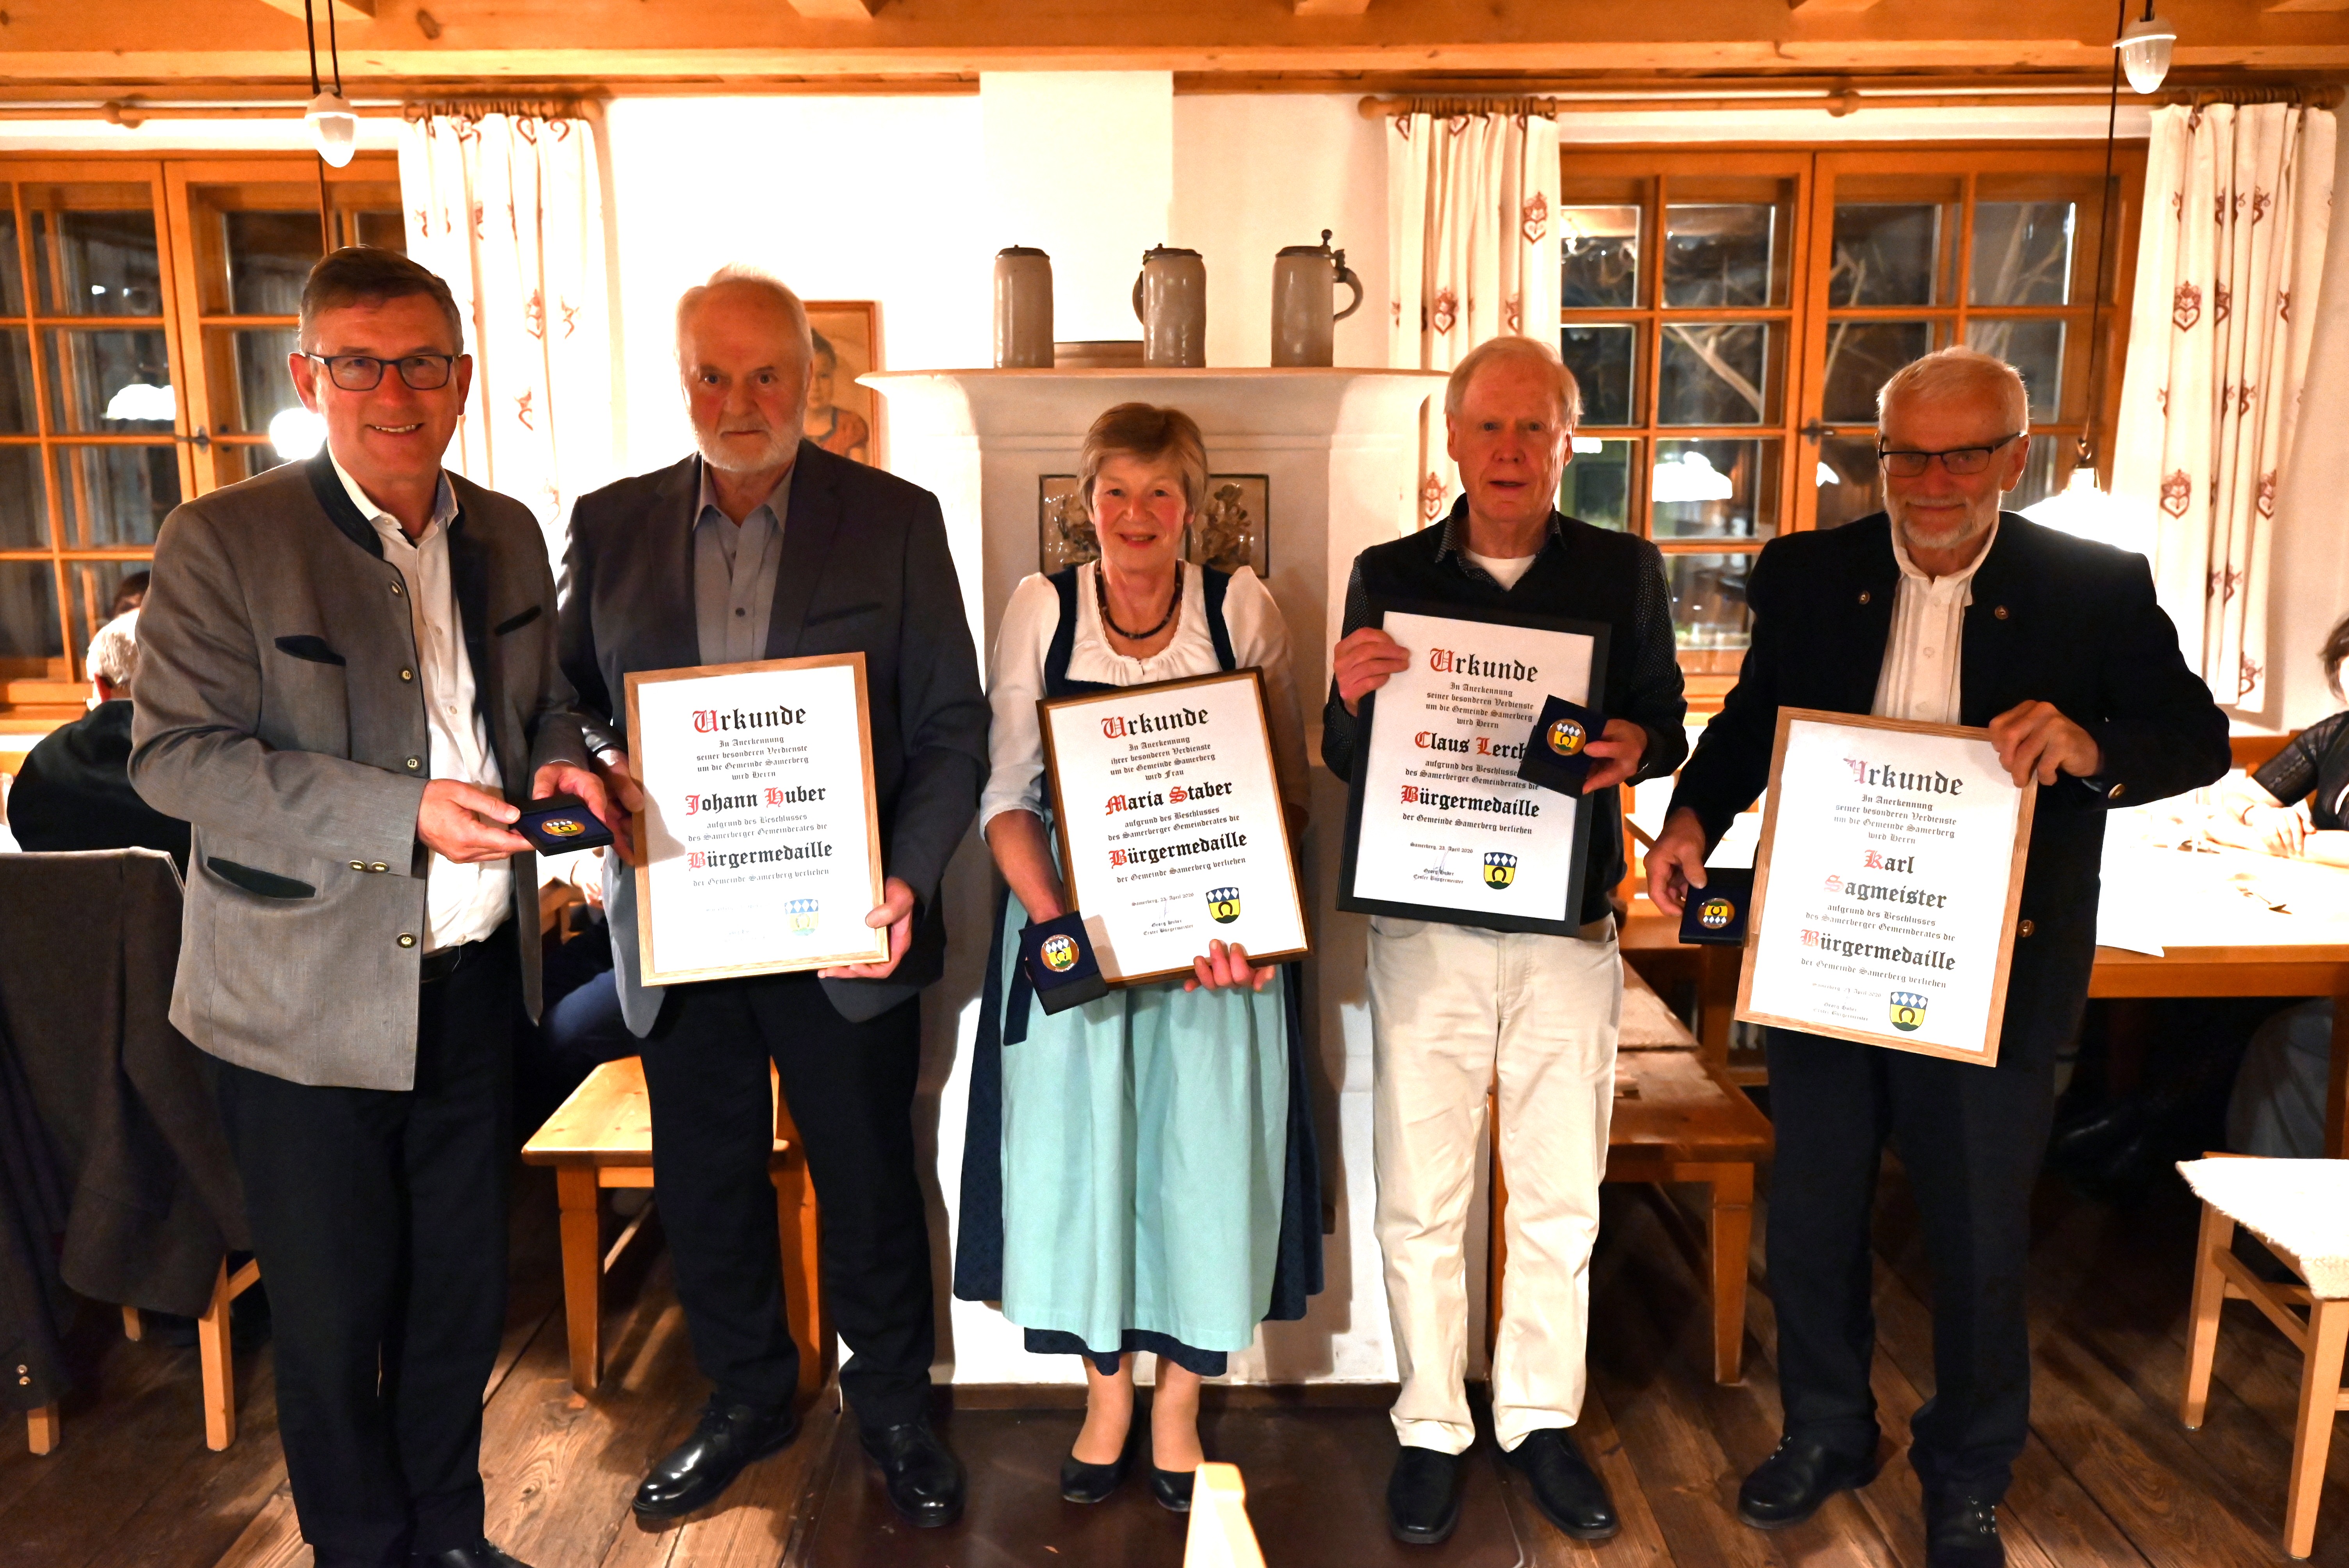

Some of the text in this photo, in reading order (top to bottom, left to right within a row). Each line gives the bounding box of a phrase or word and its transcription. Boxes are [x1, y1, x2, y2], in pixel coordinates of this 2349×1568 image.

[1430, 648, 1538, 682] Urkunde
[1449, 682, 1513, 697] In Anerkennung
[1451, 694, 1492, 705] besonderen
[1494, 698, 1534, 710] Verdienste
[692, 705, 806, 733] Urkunde
[1101, 707, 1209, 739] Urkunde
[1452, 705, 1488, 716] Gemeinde
[1490, 709, 1533, 722] Samerberg
[1476, 718, 1499, 729] Herrn
[722, 750, 764, 758] besonderen
[766, 746, 807, 754] Verdienste
[732, 737, 784, 746] Anerkennung
[1141, 737, 1191, 749] Anerkennung
[1415, 731, 1470, 753] Claus
[1130, 750, 1170, 761] besonderen
[1172, 744, 1211, 755] Verdienste
[1136, 761, 1171, 772] Gemeinde
[1174, 754, 1215, 766] Samerberg
[725, 761, 763, 770] Gemeinde
[765, 757, 809, 766] Samerberg
[1425, 760, 1518, 777] aufgrund des Beschlusse
[1145, 770, 1184, 780] wird Frau
[1405, 768, 1418, 776] des
[1419, 770, 1470, 783] Samerberger
[1472, 776, 1526, 789] Gemeinderates
[685, 786, 826, 816] Johann Huber
[1105, 781, 1232, 816] Maria Staber
[1401, 785, 1540, 818] Bürgermedaille
[1861, 794, 1933, 811] In Anerkennung
[707, 819, 742, 829] aufgrund
[759, 814, 807, 823] Beschlusses
[1125, 817, 1158, 828] aufgrund
[1174, 807, 1220, 820] Beschlusses
[1416, 814, 1453, 825] Gemeinde
[1454, 819, 1497, 832] Samerberg
[1499, 824, 1532, 834] verliehen
[1863, 807, 1908, 819] besonderen
[1912, 812, 1957, 825] Verdienste
[703, 831, 755, 840] Samerberger
[757, 825, 814, 835] Gemeinderates
[1122, 827, 1171, 839] Samerberger
[1173, 817, 1227, 831] Gemeinderates
[1863, 818, 1904, 830] Gemeinde
[1906, 824, 1955, 839] Samerberg
[1868, 832, 1916, 844] wird Herrn
[687, 841, 832, 871] Bürgermedaille
[1108, 831, 1247, 869] Bürgermedaille
[1131, 870, 1167, 881] Gemeinde
[1169, 863, 1212, 874] Samerberg
[1213, 858, 1246, 868] verliehen
[1864, 850, 1915, 874] Karl
[708, 876, 745, 885] Gemeinde
[749, 872, 793, 881] Samerberg
[795, 869, 829, 877] verliehen
[1824, 875, 1947, 909] Sagmeister
[1827, 905, 1936, 926] aufgrund des Beschlusses
[1821, 914, 1876, 929] Samerberger
[1878, 923, 1941, 939] Gemeinderates
[1943, 933, 1955, 941] die
[1800, 929, 1956, 970] Bürgermedaille
[1801, 958, 1946, 988] der Gemeinde Samerberg verliehen
